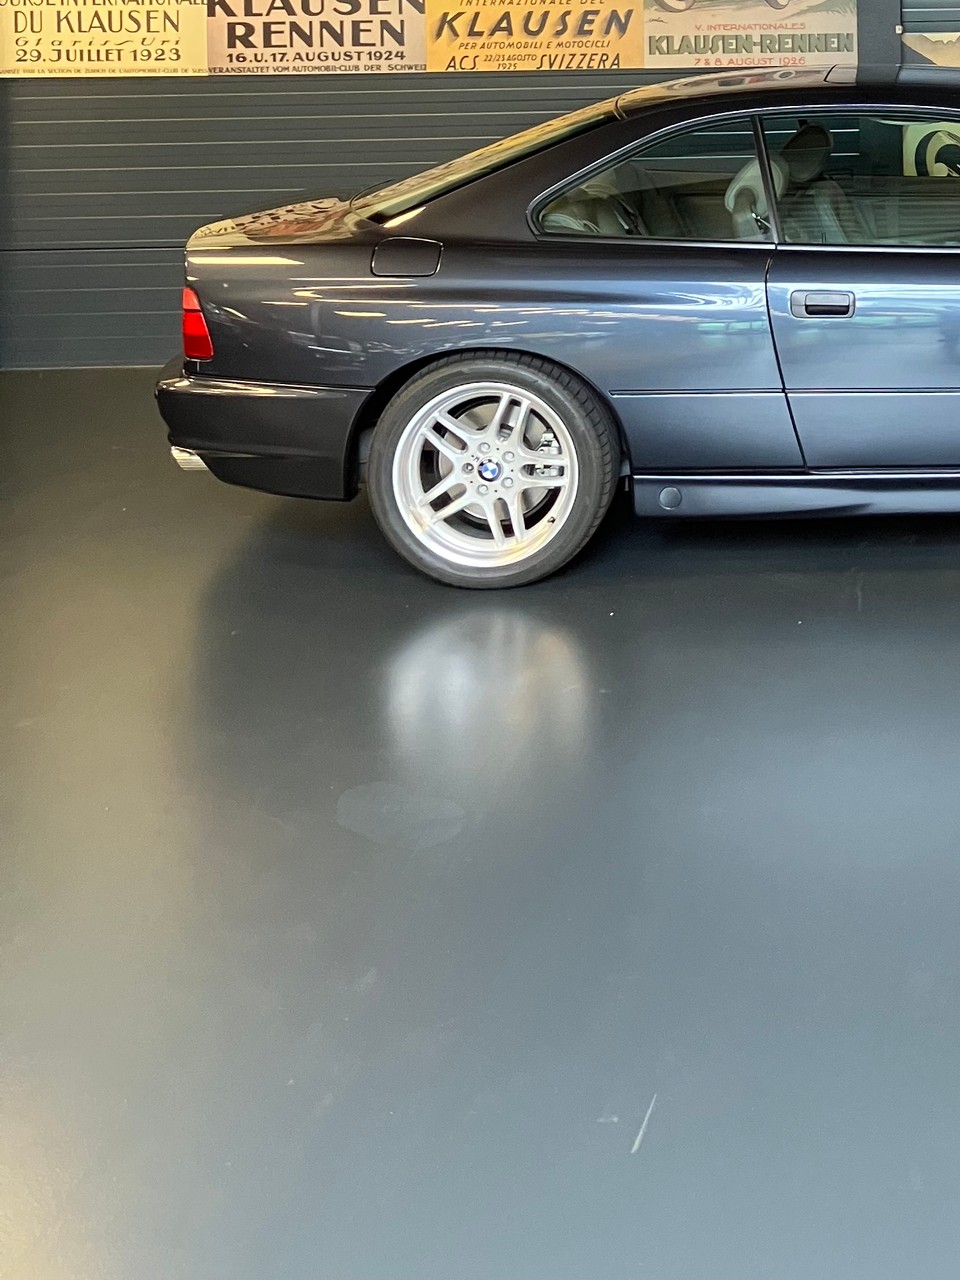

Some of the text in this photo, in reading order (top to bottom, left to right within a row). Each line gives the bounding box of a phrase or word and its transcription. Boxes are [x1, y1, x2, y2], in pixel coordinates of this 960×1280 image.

[14, 9, 180, 33] DU KLAUSEN
[433, 9, 634, 41] KLAUSEN
[707, 22, 806, 31] INTERNATIONALES
[226, 19, 405, 49] RENNEN
[458, 40, 611, 51] PER AUTOMOBILI E MOTOCICLI
[648, 33, 854, 55] KLAUSEN-RENNEN
[49, 48, 124, 62] JUILLET
[130, 48, 181, 61] 1923
[292, 50, 365, 62] AUGUST
[367, 50, 406, 61] 1924
[536, 53, 620, 69] SVIZZERA
[728, 57, 774, 65] AUGUST
[779, 56, 806, 65] 1926
[208, 66, 270, 74] VERANSTALTET
[364, 64, 382, 72] DER
